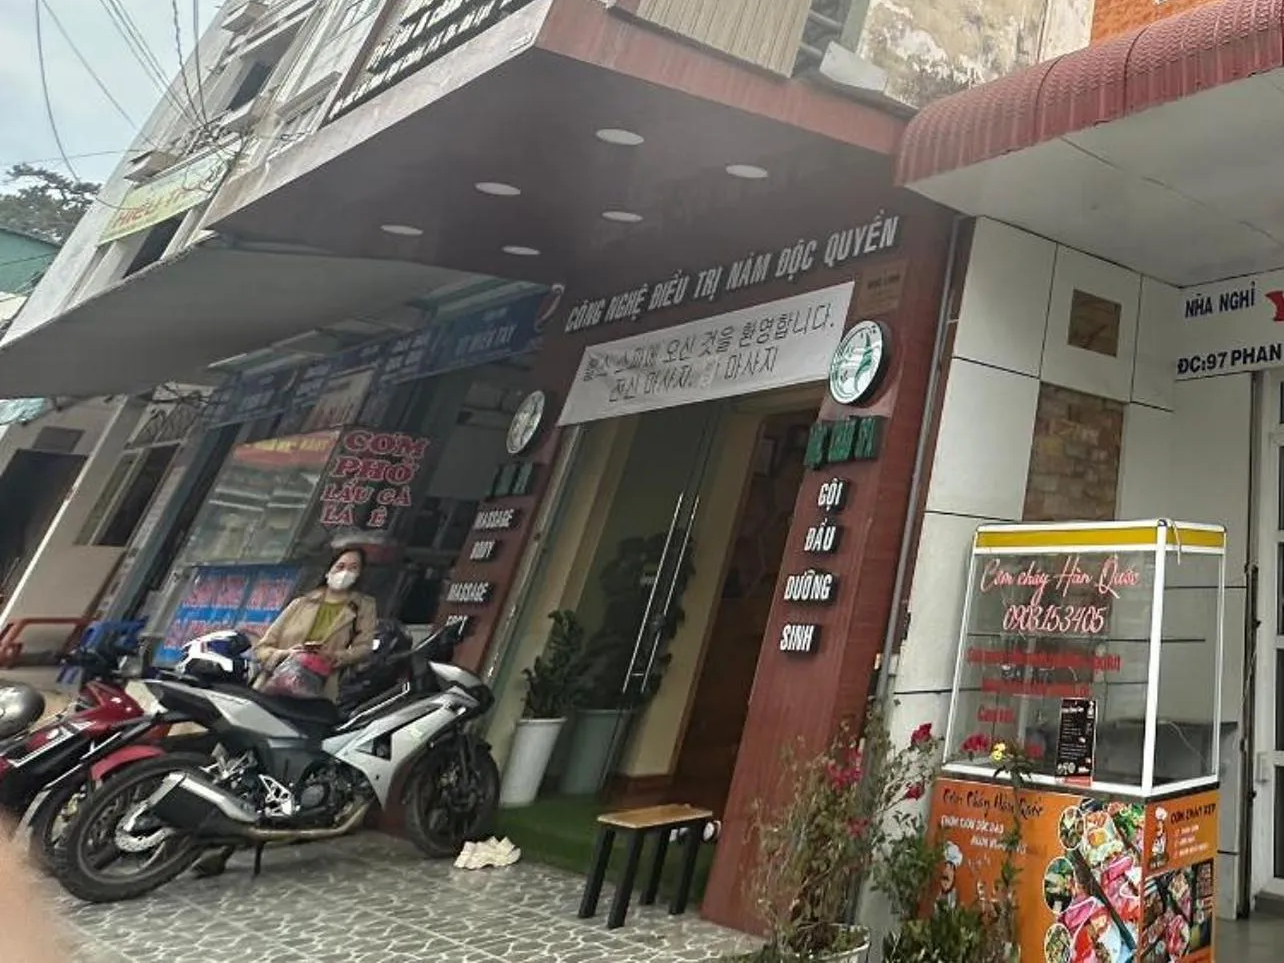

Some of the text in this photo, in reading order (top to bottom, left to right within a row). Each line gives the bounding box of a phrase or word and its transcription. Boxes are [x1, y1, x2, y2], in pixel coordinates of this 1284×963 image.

[564, 298, 606, 335] CÔNG
[604, 282, 649, 324] NGHỆ
[693, 264, 723, 303] TRỊ
[775, 237, 816, 281] ĐỘC
[1230, 341, 1284, 367] PHAN
[818, 476, 844, 513] GỘI
[783, 569, 834, 602] DƯỠNG
[780, 623, 816, 653] SINH
